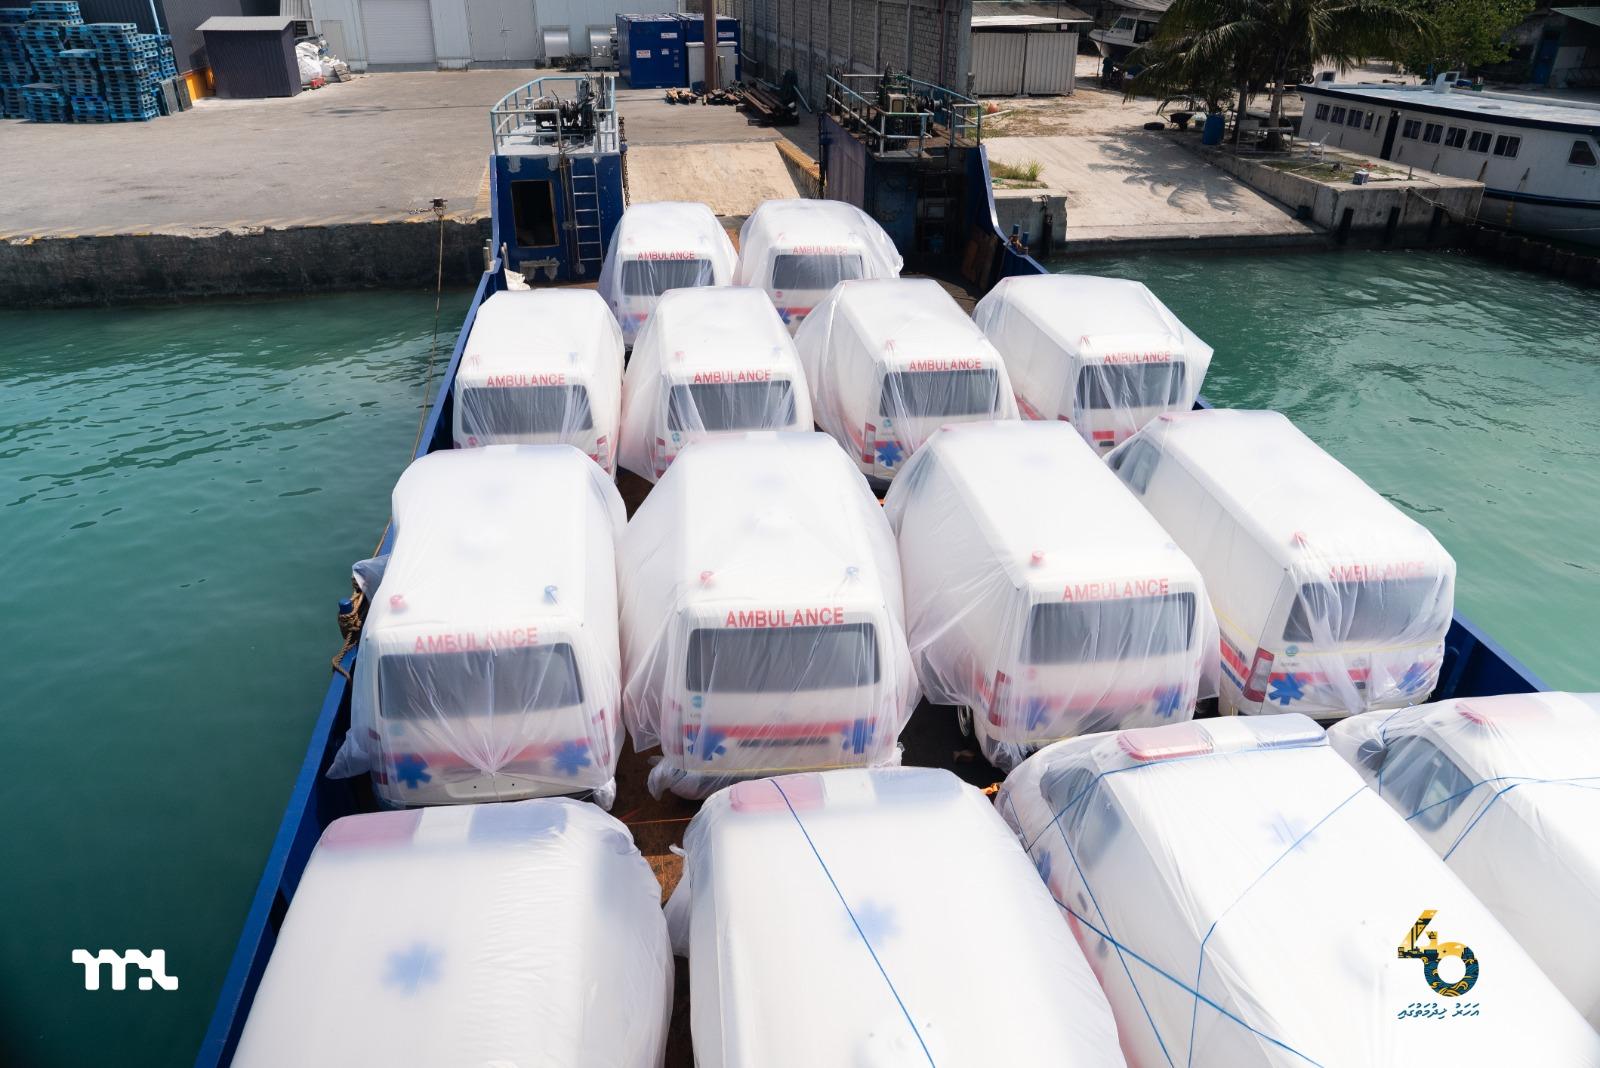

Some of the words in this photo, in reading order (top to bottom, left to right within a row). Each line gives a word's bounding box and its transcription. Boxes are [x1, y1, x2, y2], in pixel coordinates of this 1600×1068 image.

[638, 250, 695, 261] AMBULANCE
[909, 357, 982, 373] AMBULANCE
[487, 373, 566, 388] AMBULANCE
[694, 369, 771, 385] AMBULANCE
[1063, 578, 1169, 602] AMBULANCE
[726, 607, 844, 629] AMBULANCE
[414, 627, 539, 654] AMBULANCE
